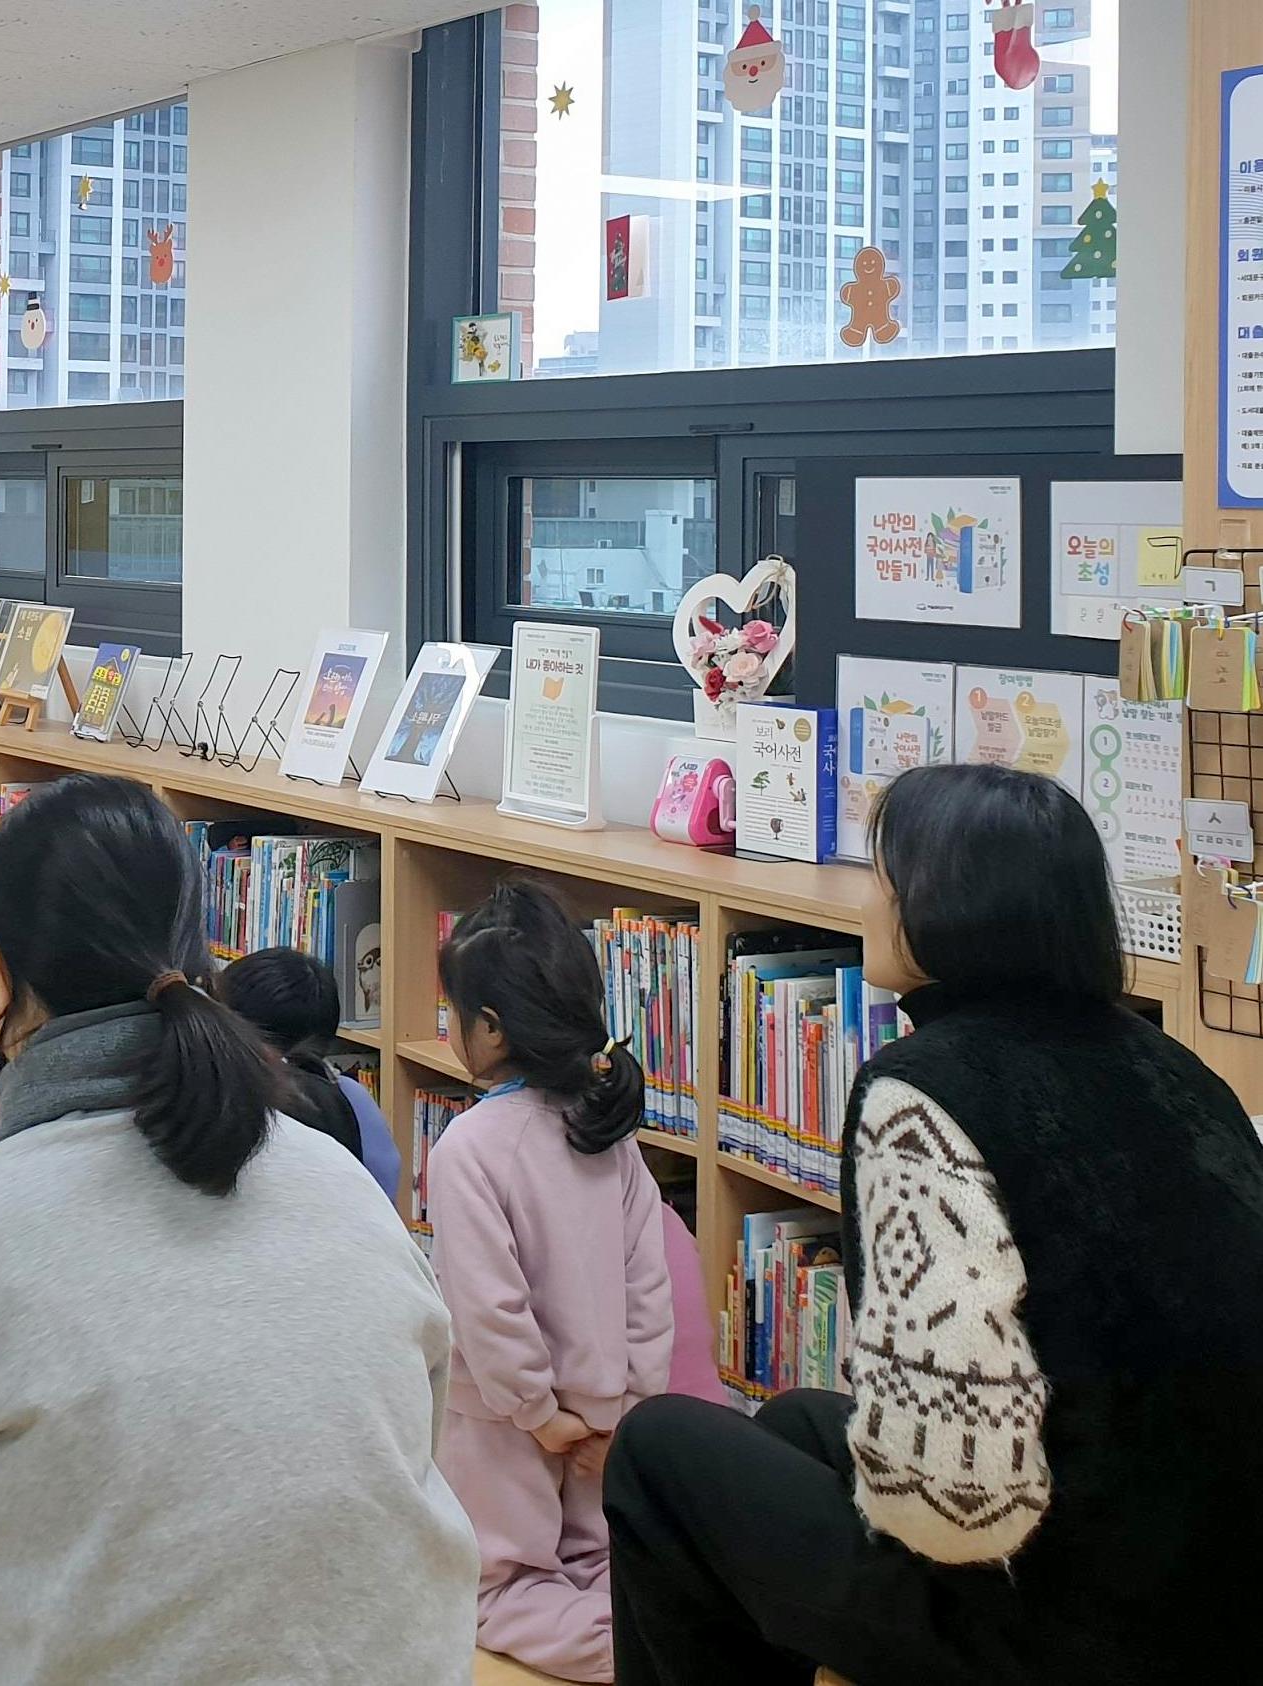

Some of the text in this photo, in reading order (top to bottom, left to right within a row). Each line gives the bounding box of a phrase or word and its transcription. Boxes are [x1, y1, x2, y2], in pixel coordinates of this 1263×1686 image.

[873, 513, 916, 534] 나만의
[866, 536, 922, 558] 국어사전
[1067, 535, 1114, 559] 오늘의
[876, 559, 917, 582] 만들기
[1077, 561, 1109, 586] 초성
[525, 658, 584, 675] 내가 좋아하는 것
[752, 741, 803, 763] 국어사전
